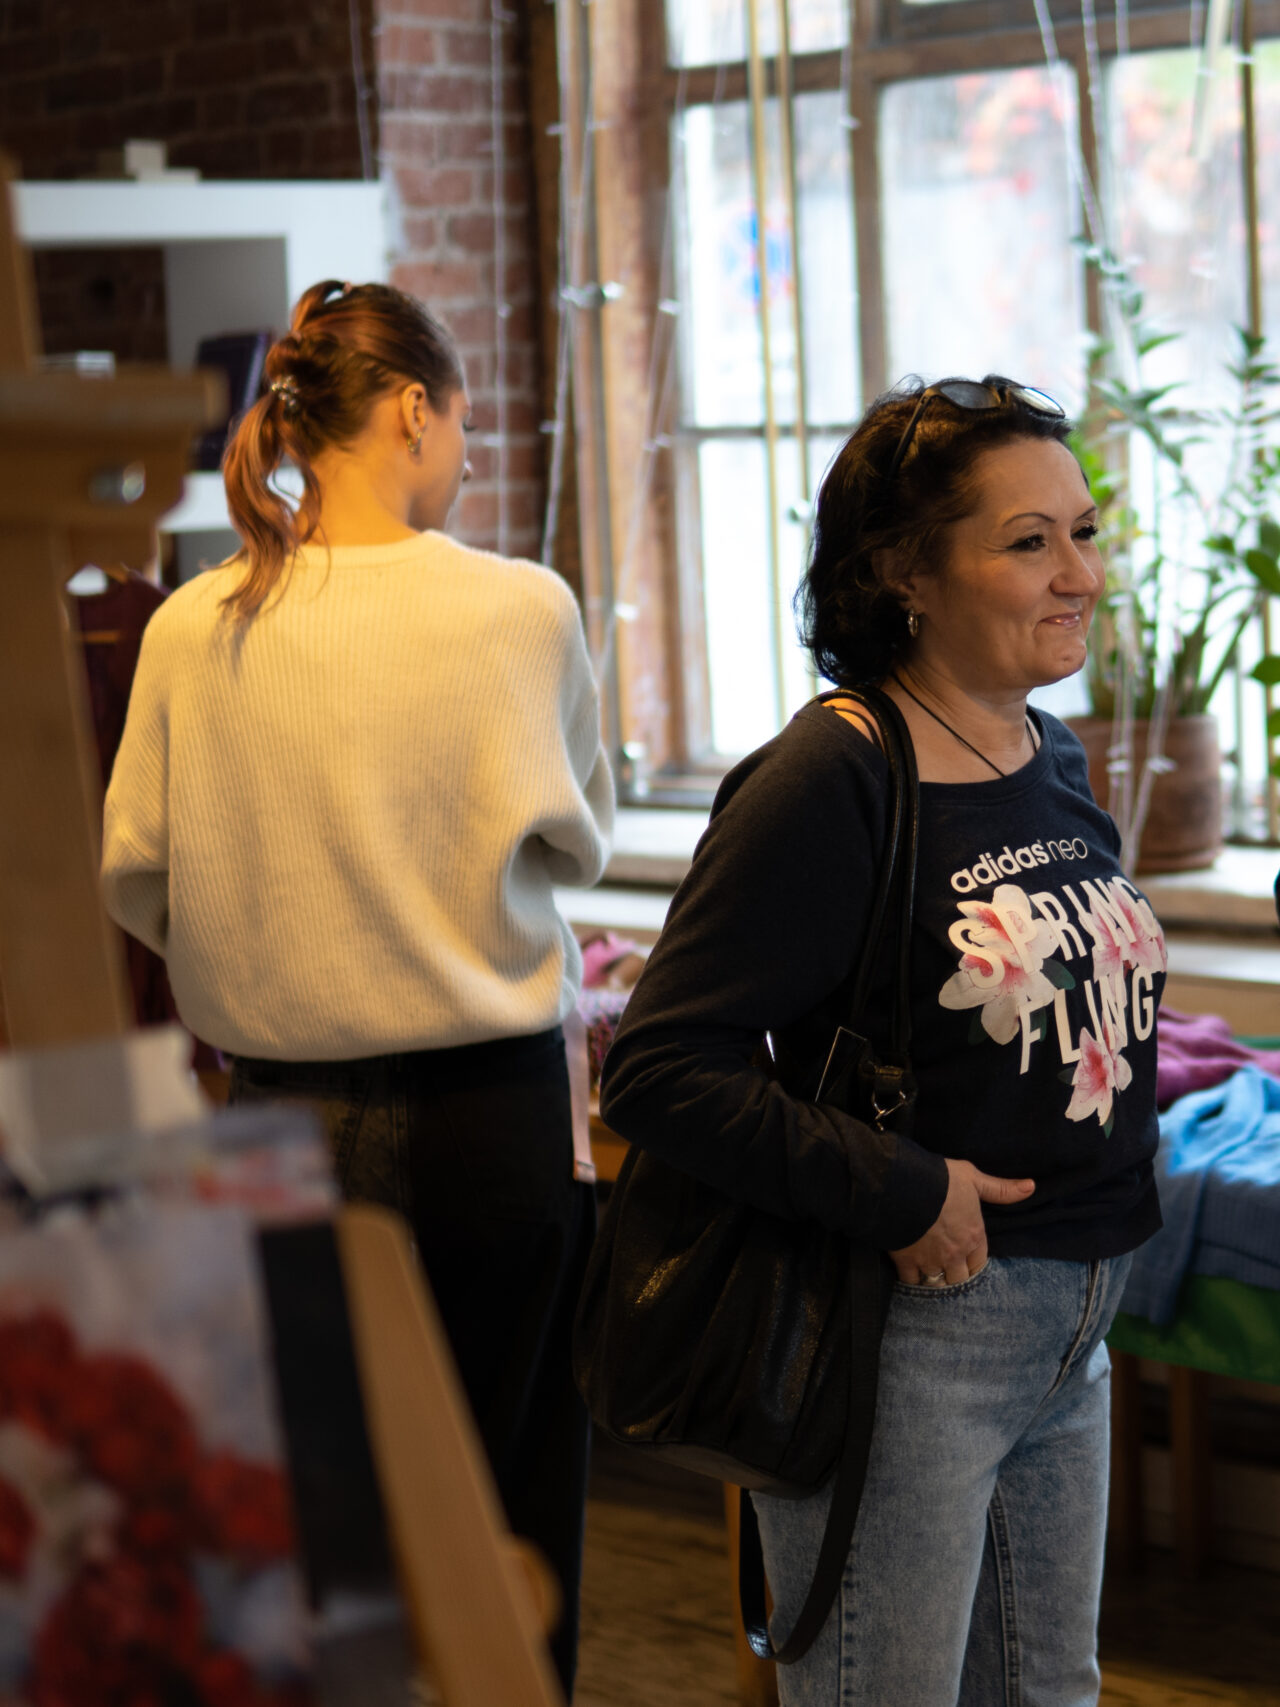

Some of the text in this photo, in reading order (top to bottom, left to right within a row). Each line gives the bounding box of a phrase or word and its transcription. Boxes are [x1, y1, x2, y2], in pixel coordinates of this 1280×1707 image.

[951, 837, 1088, 894] adidas neo
[948, 875, 1158, 990] SPRING
[1019, 966, 1154, 1076] FLING
